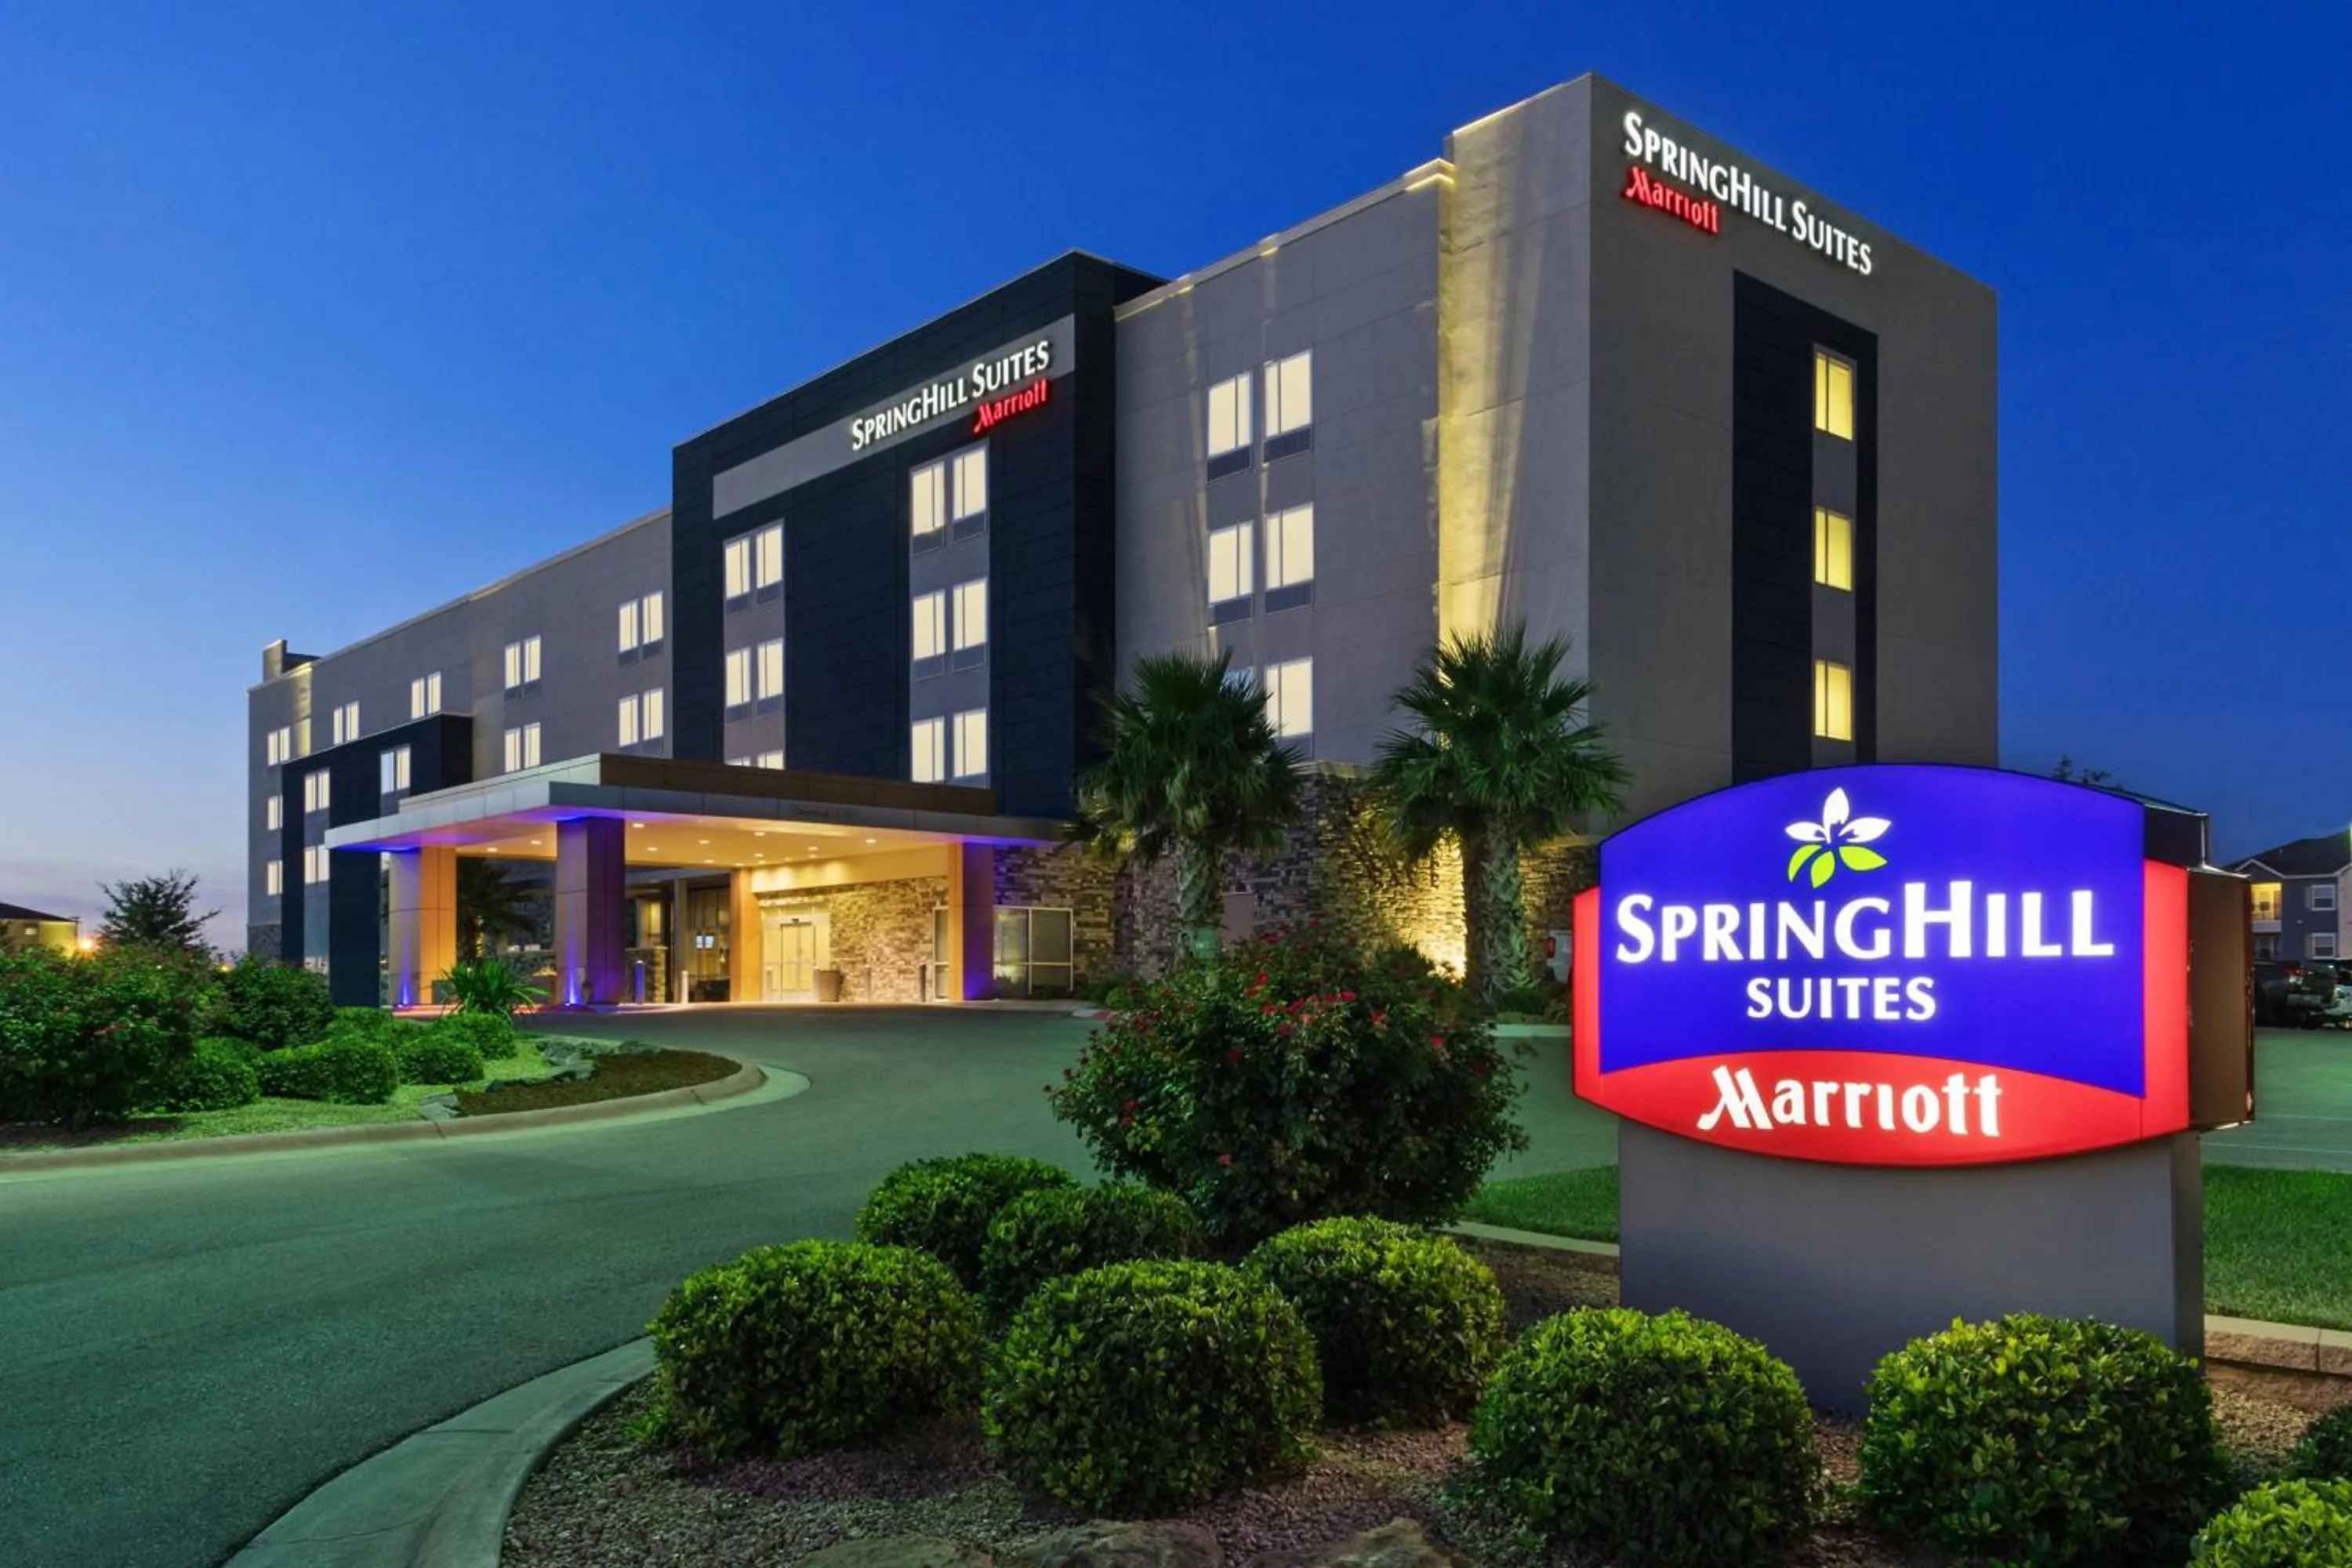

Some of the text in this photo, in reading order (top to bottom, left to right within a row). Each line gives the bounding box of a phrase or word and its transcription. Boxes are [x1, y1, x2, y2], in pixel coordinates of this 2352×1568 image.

[1623, 111, 1872, 275] SPRINGHILL SUITES
[1624, 166, 1719, 234] Marriott
[851, 340, 1050, 451] SPRINGHILL SUITES
[973, 379, 1048, 433] Marriott
[1615, 880, 2115, 964] SPRINGHILL
[1745, 976, 1936, 1020] SUITES
[1697, 1065, 2002, 1137] Marriott
